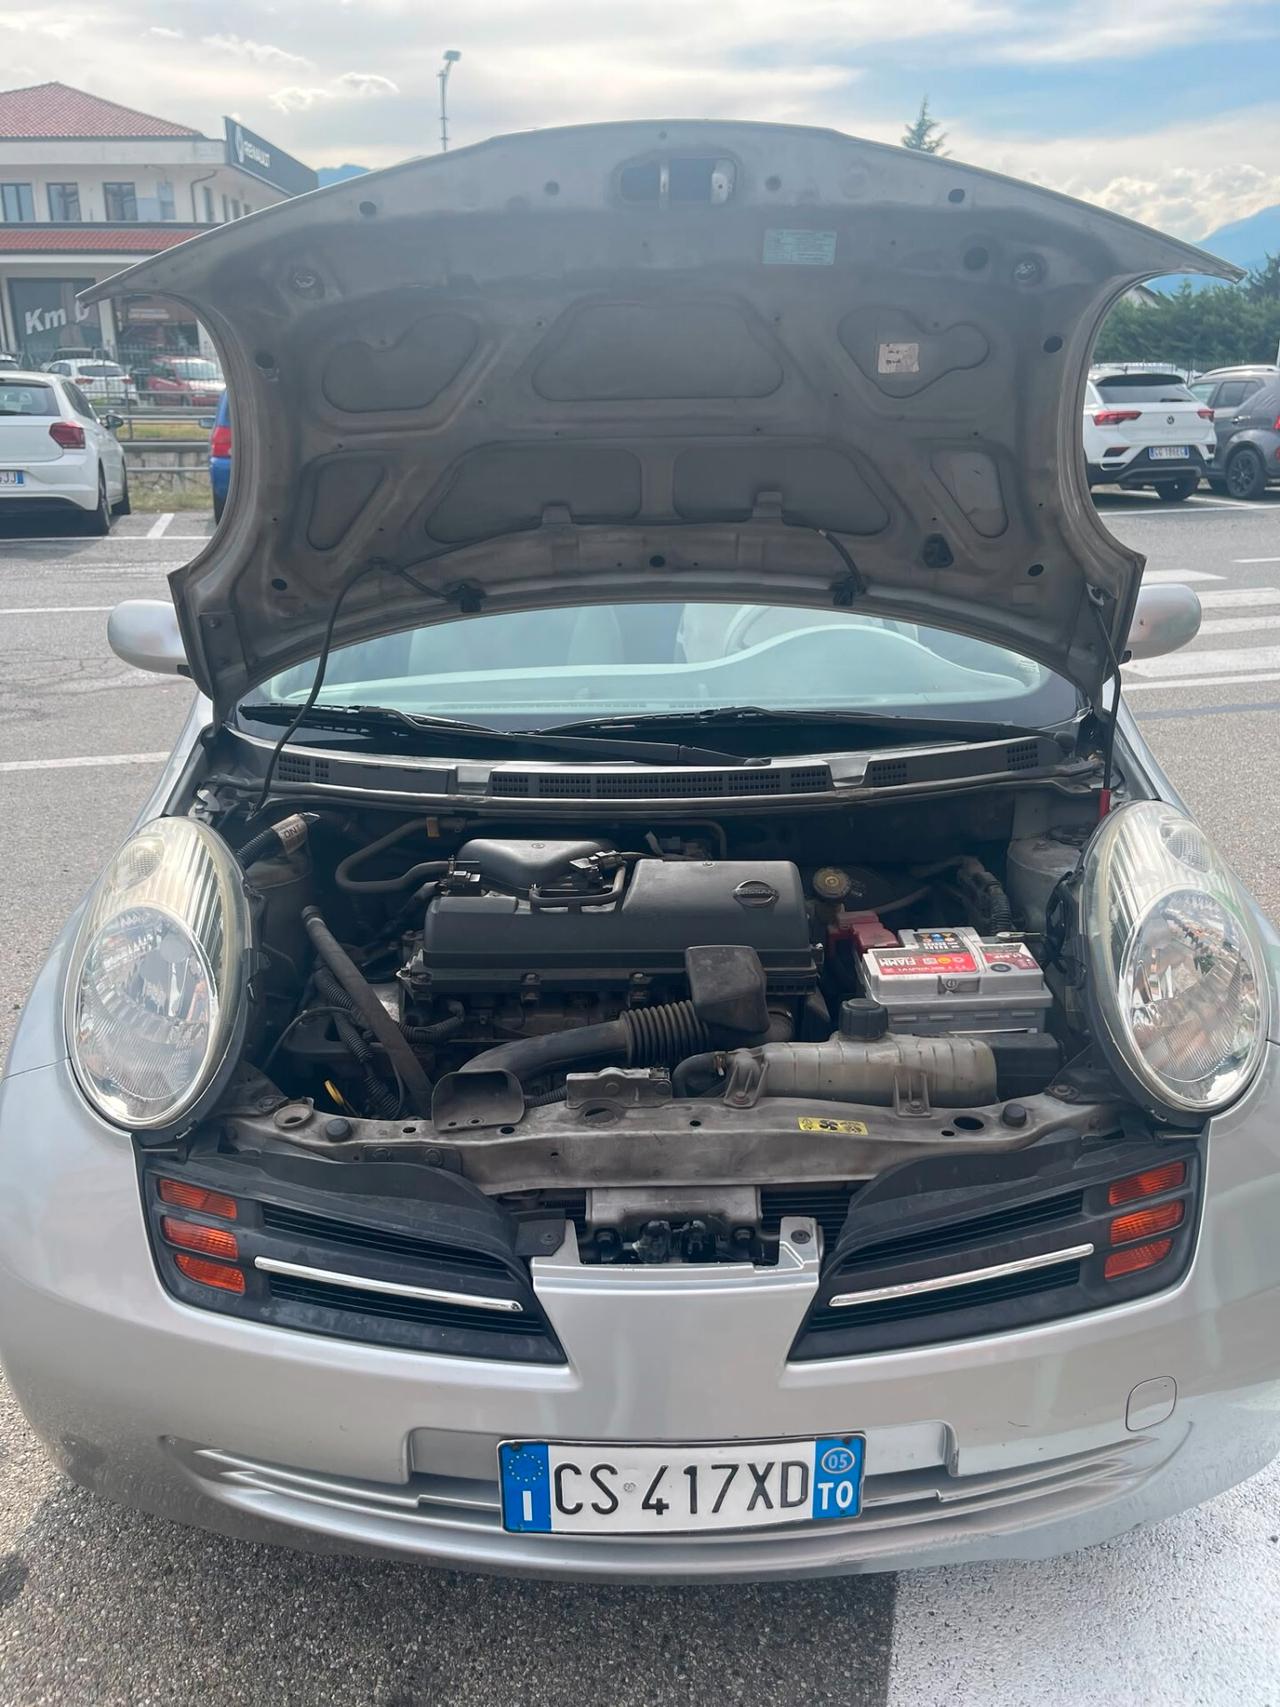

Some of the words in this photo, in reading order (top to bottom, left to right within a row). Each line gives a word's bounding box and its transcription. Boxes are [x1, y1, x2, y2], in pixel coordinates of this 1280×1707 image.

[25, 308, 67, 335] Km
[879, 956, 916, 967] FIAMM
[828, 1453, 849, 1469] 05
[553, 1462, 619, 1515] CS
[641, 1460, 809, 1515] 417XD
[817, 1480, 854, 1511] TO
